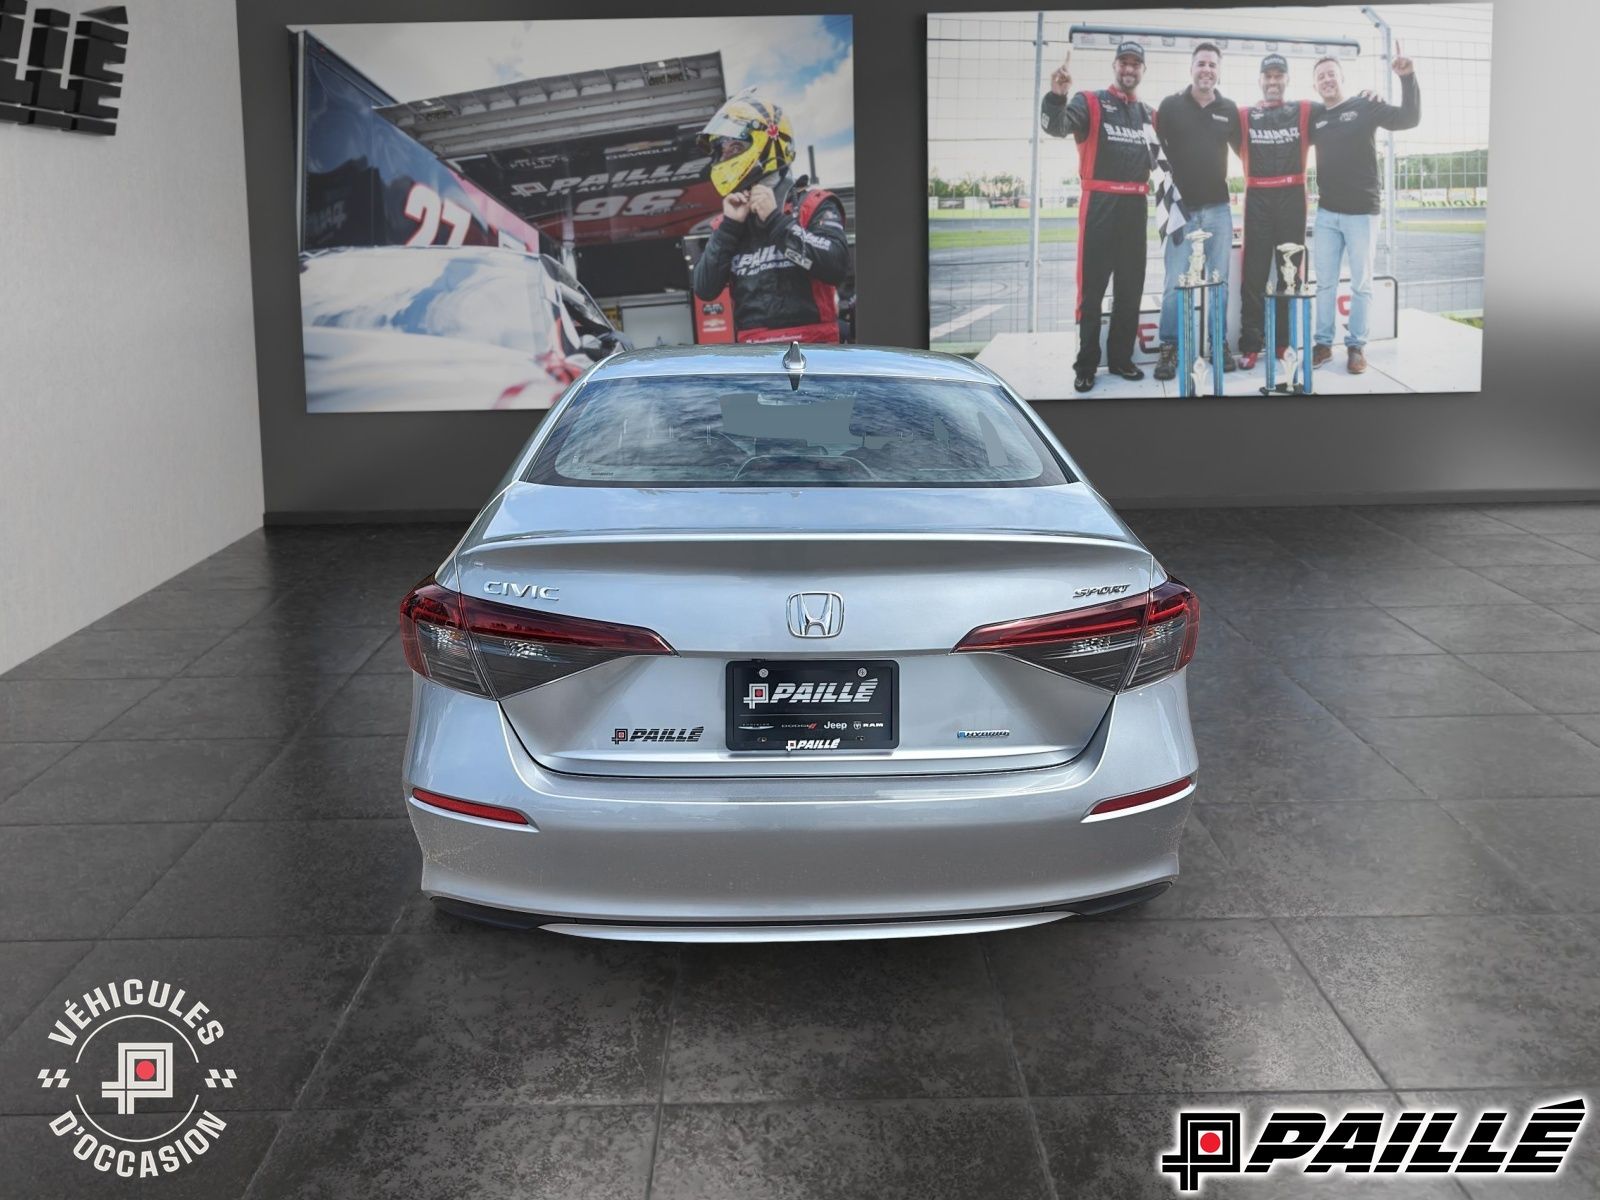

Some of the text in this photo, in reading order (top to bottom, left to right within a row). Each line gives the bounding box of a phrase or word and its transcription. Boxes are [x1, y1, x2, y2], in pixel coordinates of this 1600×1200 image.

[605, 146, 678, 160] CHEVROLET
[613, 172, 700, 189] CANADA
[574, 189, 685, 221] 96
[483, 581, 560, 601] CIVIC
[1072, 583, 1132, 599] SPORT
[769, 678, 879, 704] PAILLÉ
[823, 721, 848, 730] Jeep
[629, 726, 704, 743] PAILLÉ
[796, 738, 841, 750] PAILLÉ
